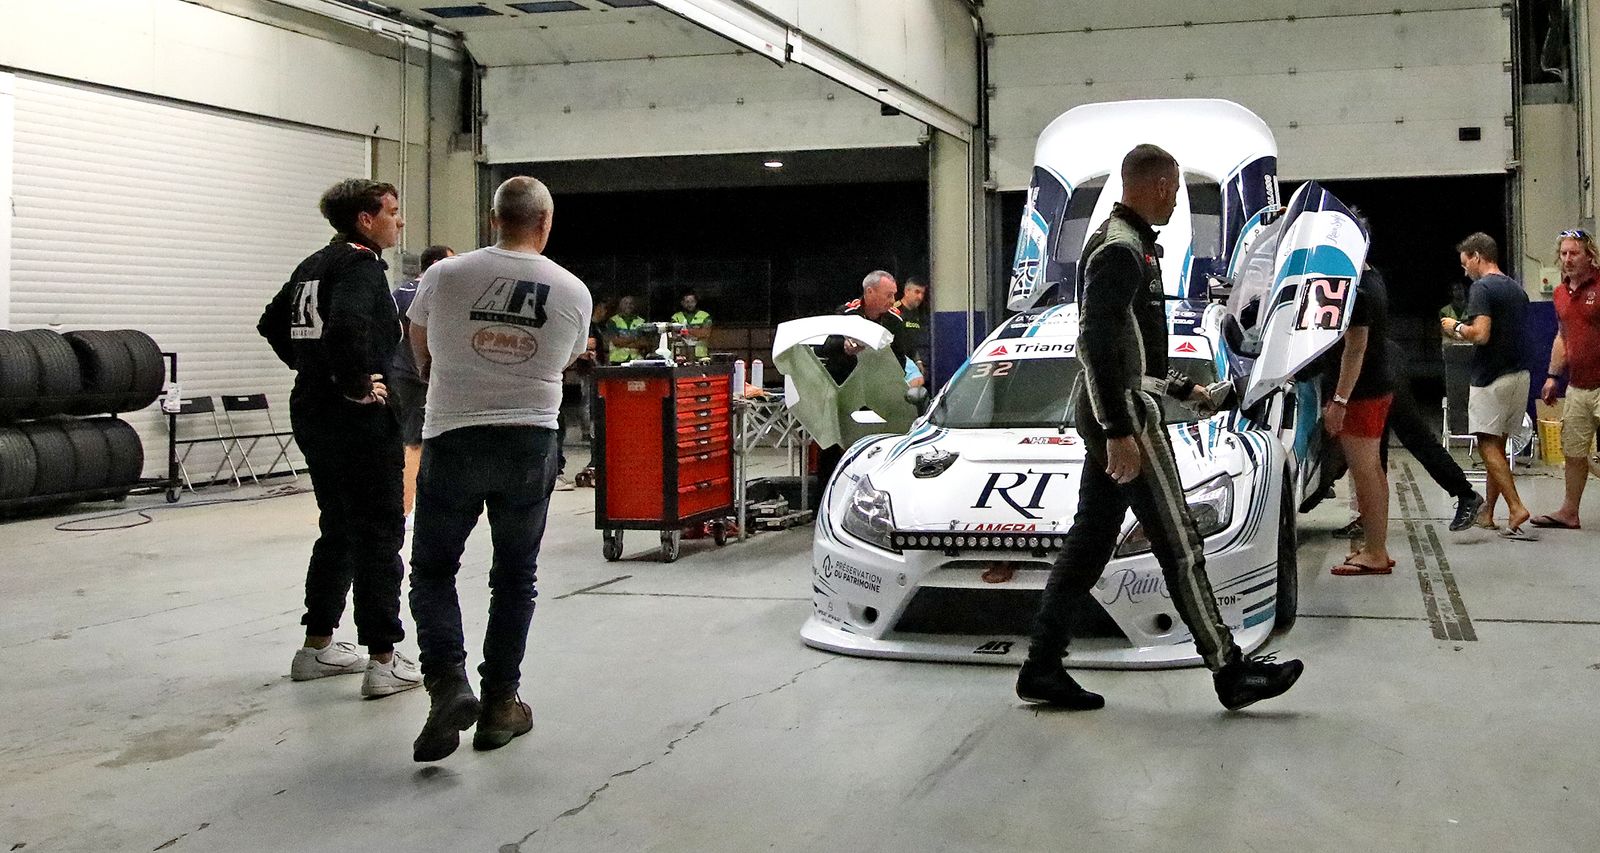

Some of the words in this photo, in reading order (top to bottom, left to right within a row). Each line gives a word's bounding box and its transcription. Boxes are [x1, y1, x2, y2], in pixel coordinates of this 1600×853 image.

[1301, 279, 1347, 327] 32
[1015, 342, 1075, 353] Triang
[972, 362, 1013, 378] 32
[970, 468, 1070, 520] RT
[834, 569, 843, 579] DU
[843, 573, 881, 593] PATRIMOINE
[836, 560, 882, 584] PRÉSERVATION
[1102, 567, 1159, 605] Rain
